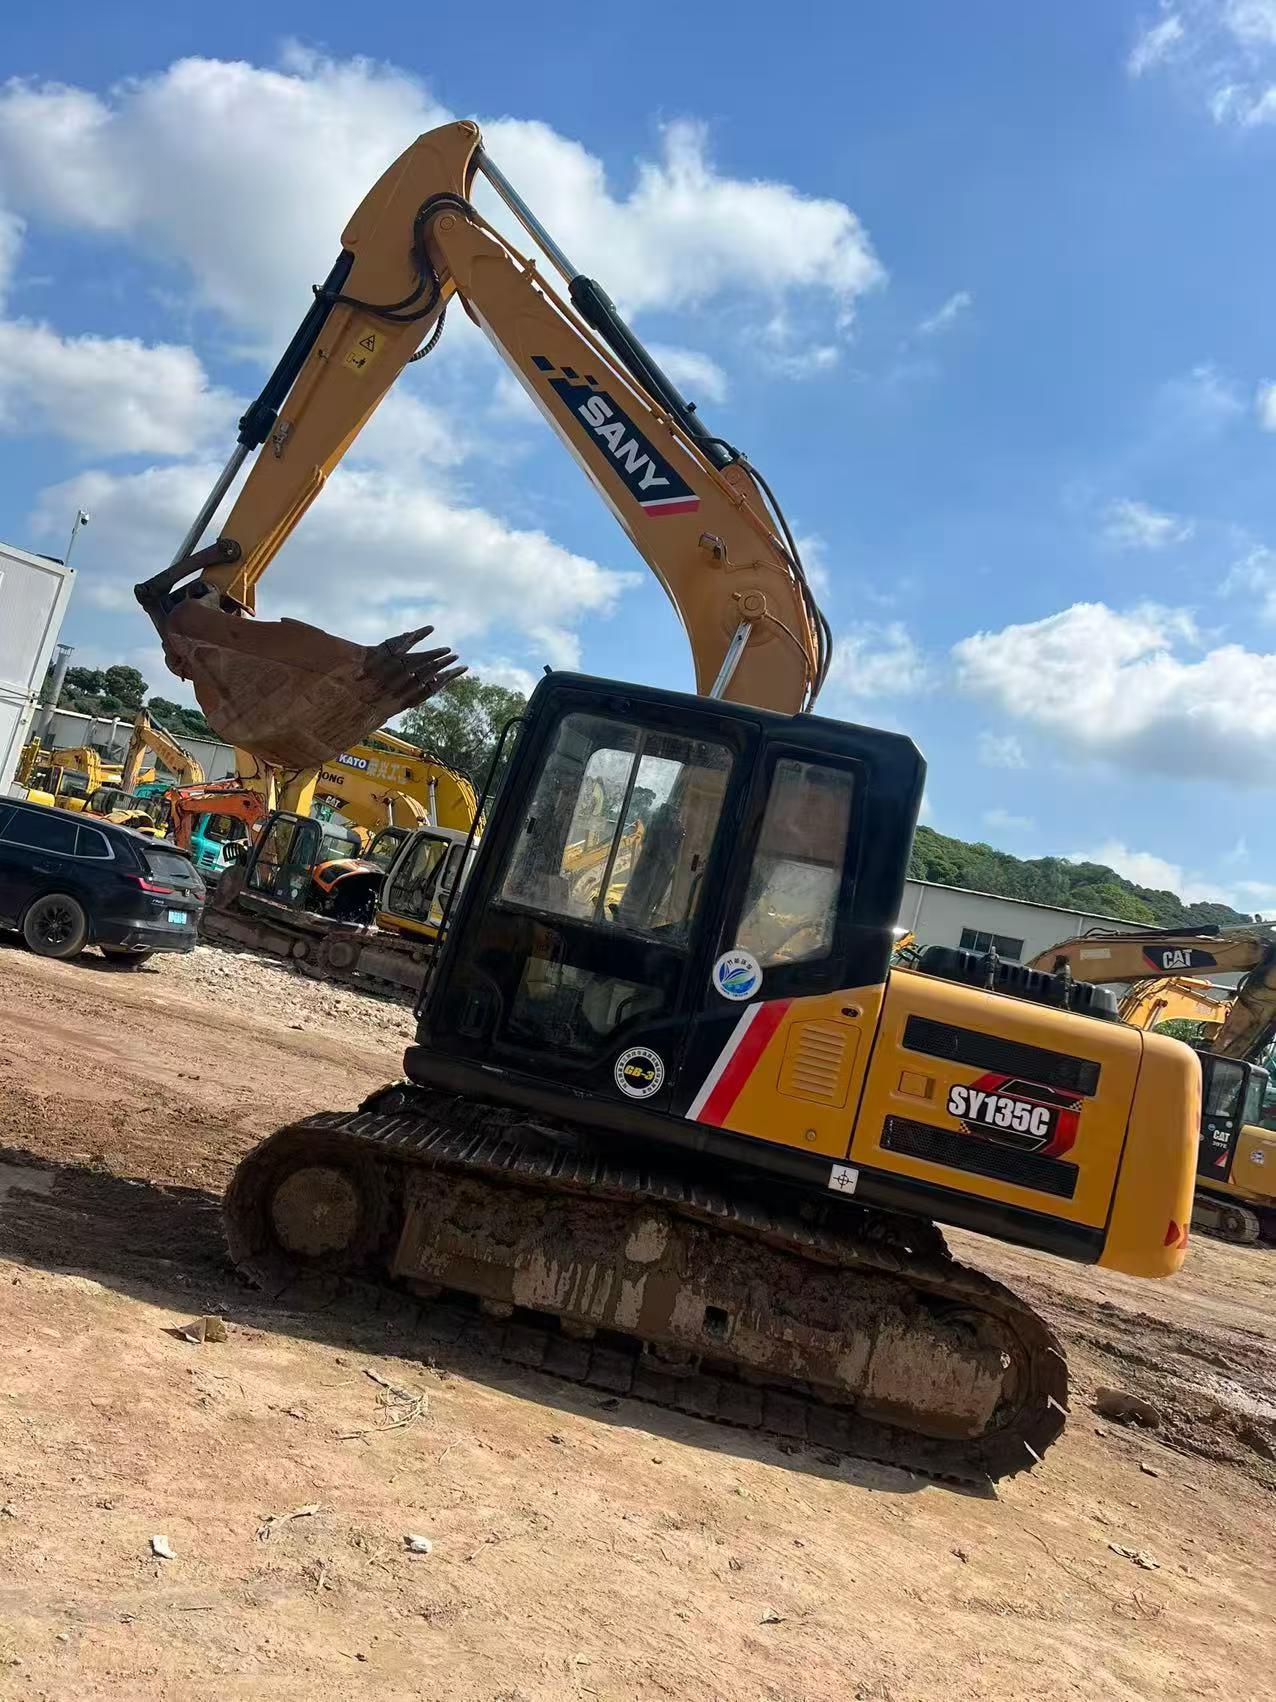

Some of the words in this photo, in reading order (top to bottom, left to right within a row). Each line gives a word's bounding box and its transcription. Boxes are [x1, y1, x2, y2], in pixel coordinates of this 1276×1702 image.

[578, 396, 670, 490] SANY
[339, 754, 366, 768] KATO
[1163, 949, 1192, 969] CAT
[624, 1065, 655, 1080] GB-3
[949, 1086, 1050, 1136] SY135C
[1213, 1129, 1231, 1142] CAT
